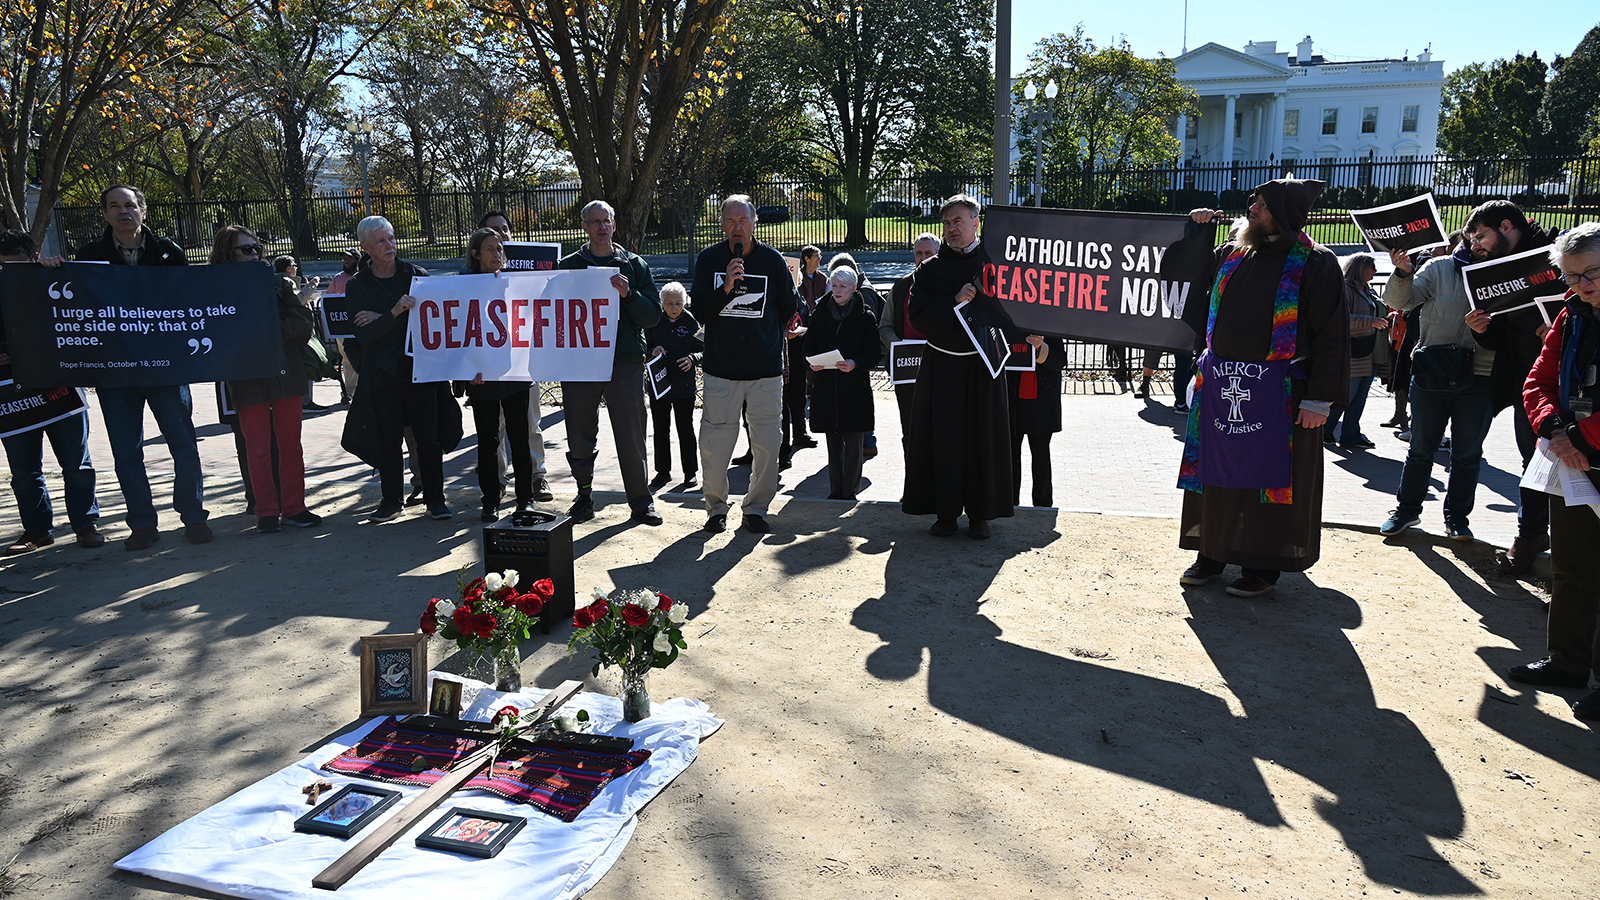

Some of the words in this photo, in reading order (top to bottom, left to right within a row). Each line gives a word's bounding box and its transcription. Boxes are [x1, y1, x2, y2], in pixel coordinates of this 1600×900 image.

[1365, 224, 1406, 239] CEASEFIRE
[1405, 217, 1430, 233] NOW
[1005, 235, 1113, 270] CATHOLICS
[1121, 244, 1167, 274] SAY
[982, 264, 1110, 312] CEASEFIRE
[1120, 276, 1191, 320] NOW
[1475, 277, 1530, 301] CEASEFIRE
[1528, 269, 1557, 286] NOW
[52, 306, 58, 318] I
[61, 308, 94, 321] urge
[98, 306, 116, 319] all
[120, 306, 185, 319] believers
[189, 306, 204, 318] to
[206, 304, 237, 316] take
[54, 321, 81, 332] one
[84, 320, 116, 332] side
[120, 320, 155, 335] only:
[159, 319, 187, 332] that
[191, 318, 206, 331] of
[419, 298, 610, 350] CEASEFIRE
[57, 334, 104, 349] peace.
[1012, 343, 1029, 352] NOW
[60, 361, 79, 370] Pope
[80, 360, 106, 370] Francis,
[108, 360, 138, 369] October
[140, 359, 150, 369] 18,
[152, 359, 171, 368] 2023
[1212, 361, 1269, 380] MERCY
[1226, 421, 1263, 435] Justice
